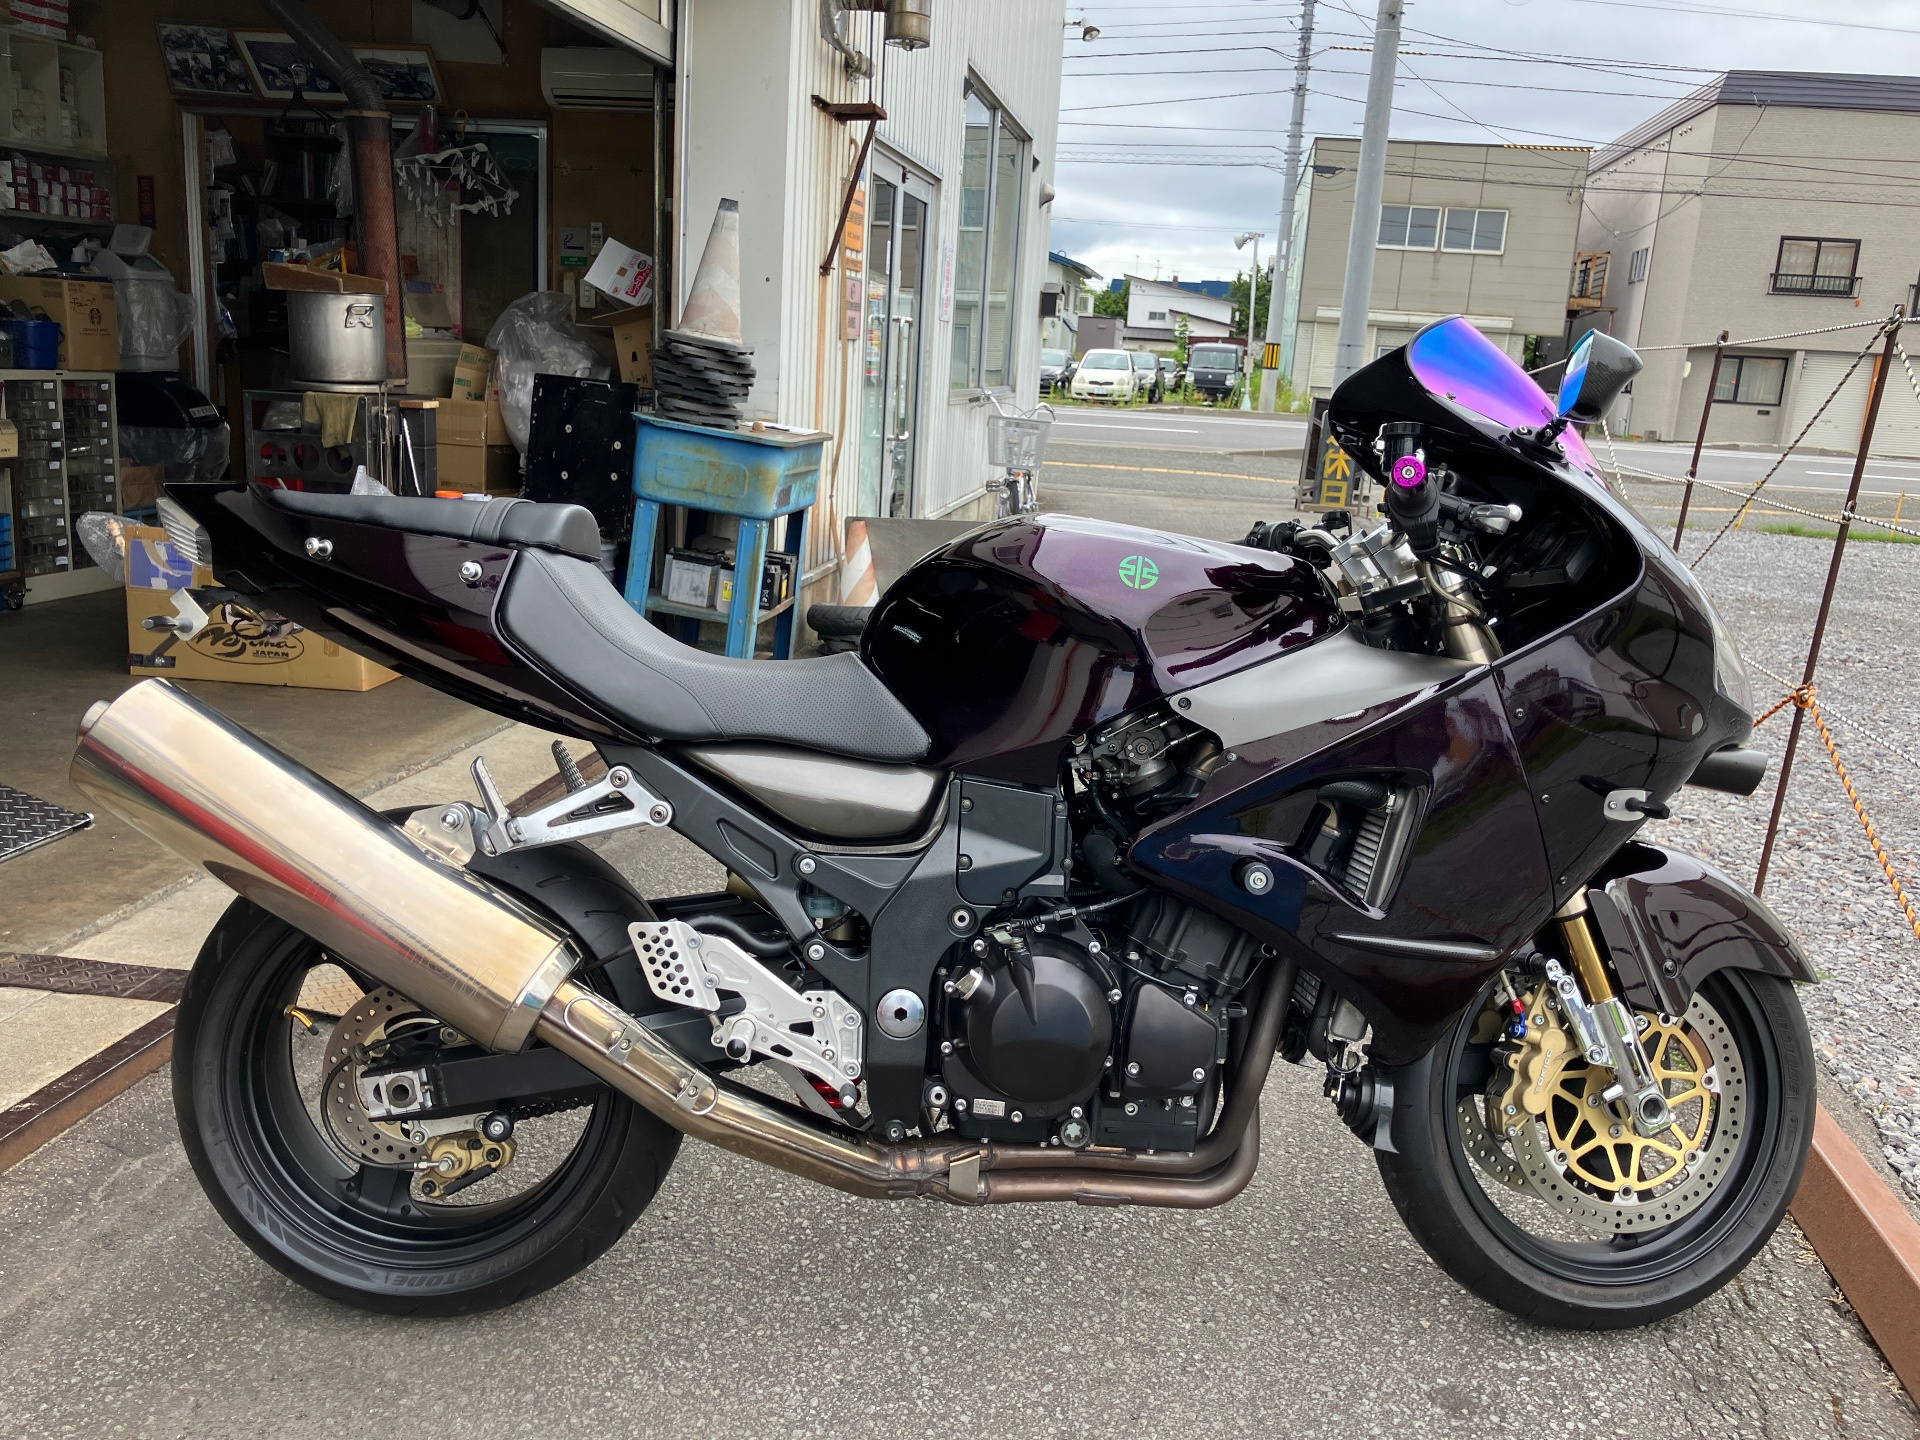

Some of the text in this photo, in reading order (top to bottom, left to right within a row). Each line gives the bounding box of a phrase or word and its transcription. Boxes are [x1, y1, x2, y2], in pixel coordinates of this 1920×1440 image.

[1320, 435, 1352, 507] 休日
[252, 649, 290, 658] JAPAN
[1534, 1048, 1553, 1094] TOKICO
